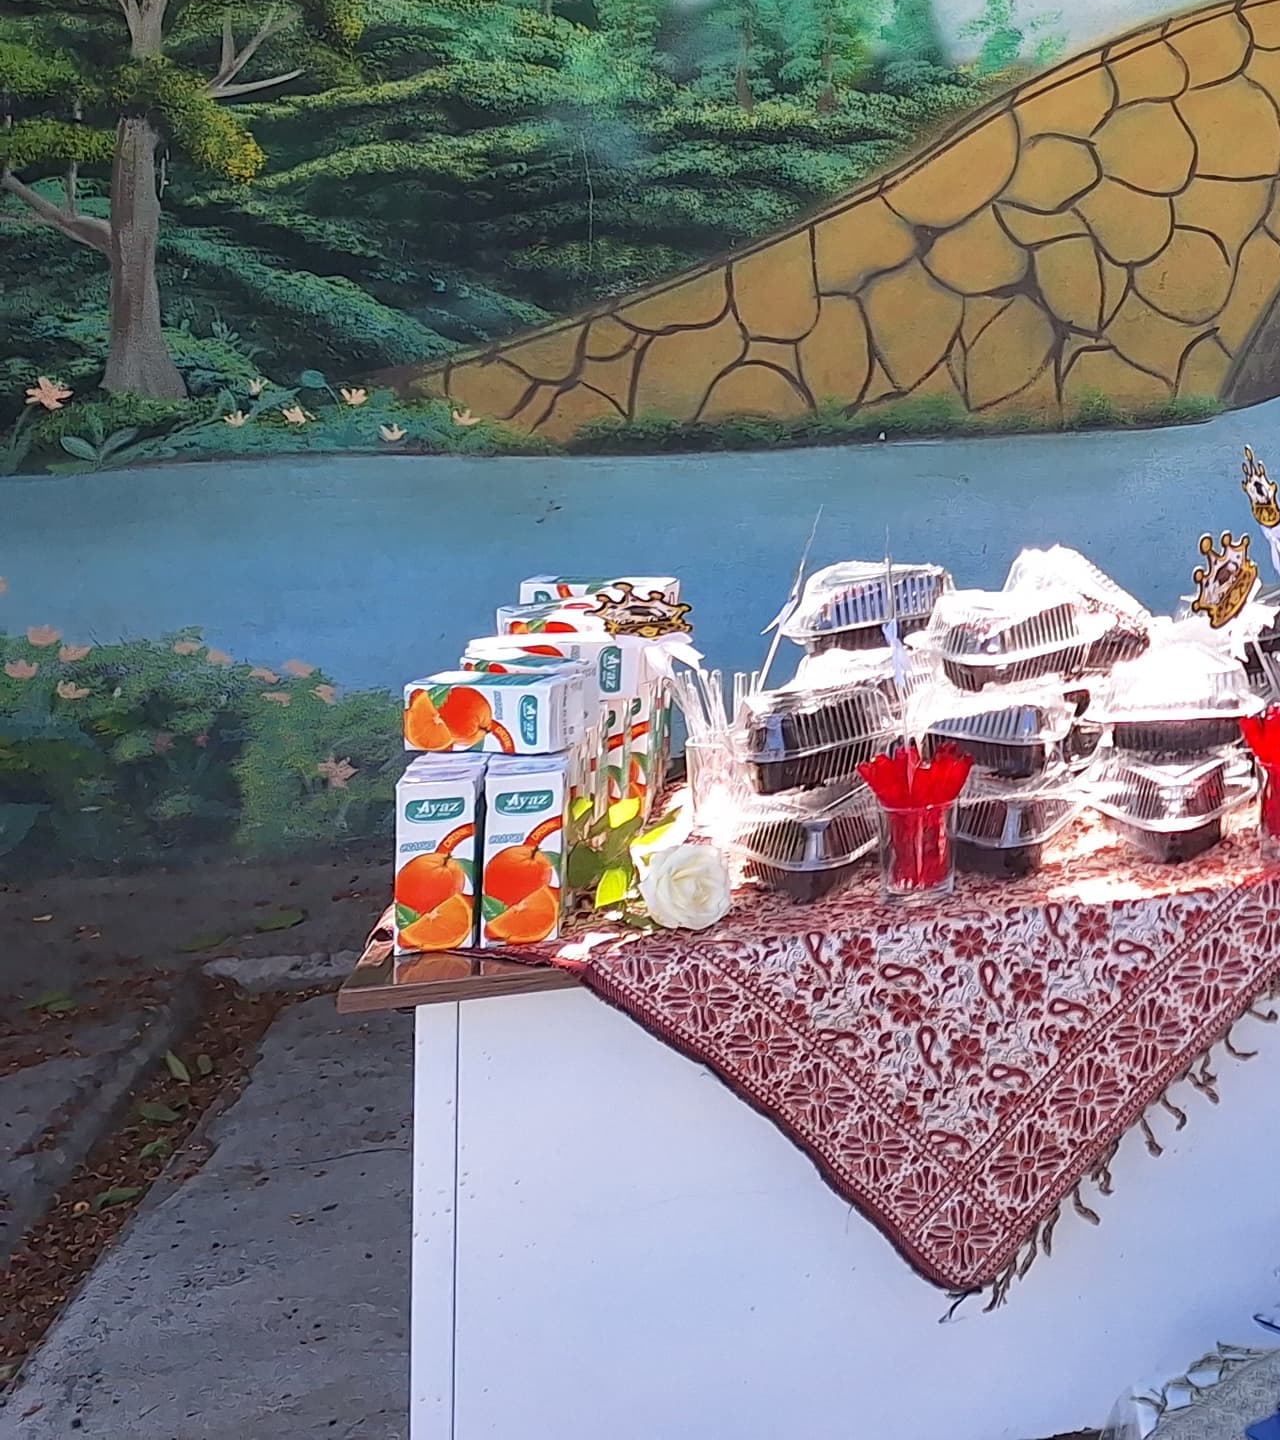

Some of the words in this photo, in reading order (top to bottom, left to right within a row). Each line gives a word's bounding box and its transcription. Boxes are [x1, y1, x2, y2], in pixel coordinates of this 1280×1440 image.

[604, 653, 621, 690] Ayaz
[523, 699, 537, 741] Ayaz
[416, 800, 461, 818] Ayaz
[506, 792, 551, 810] Ayaz
